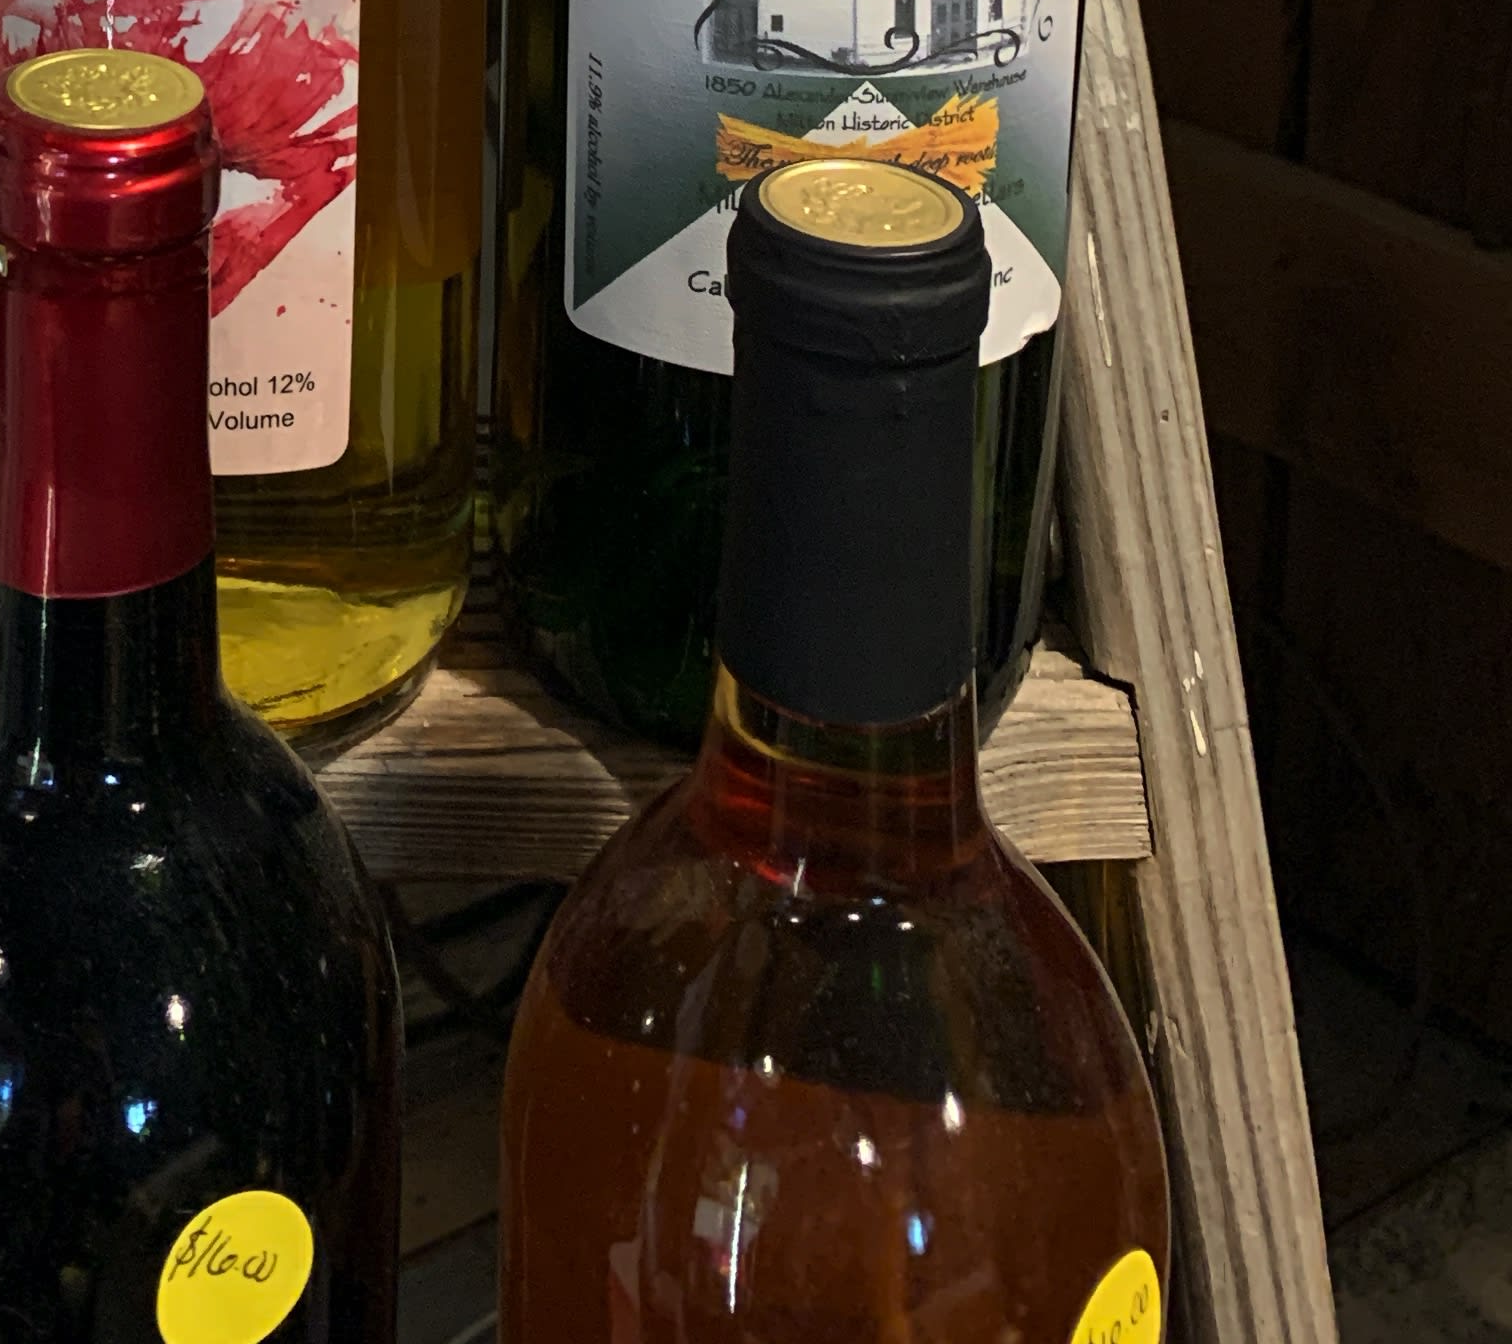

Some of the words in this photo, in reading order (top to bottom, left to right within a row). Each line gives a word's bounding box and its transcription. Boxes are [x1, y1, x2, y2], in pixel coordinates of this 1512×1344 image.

[588, 51, 604, 111] 11.9%
[705, 74, 757, 97] 1850
[841, 111, 910, 132] Historic
[208, 375, 259, 397] ohol
[267, 371, 317, 395] 12%
[208, 410, 296, 431] Volume
[167, 1215, 278, 1284] $16.00
